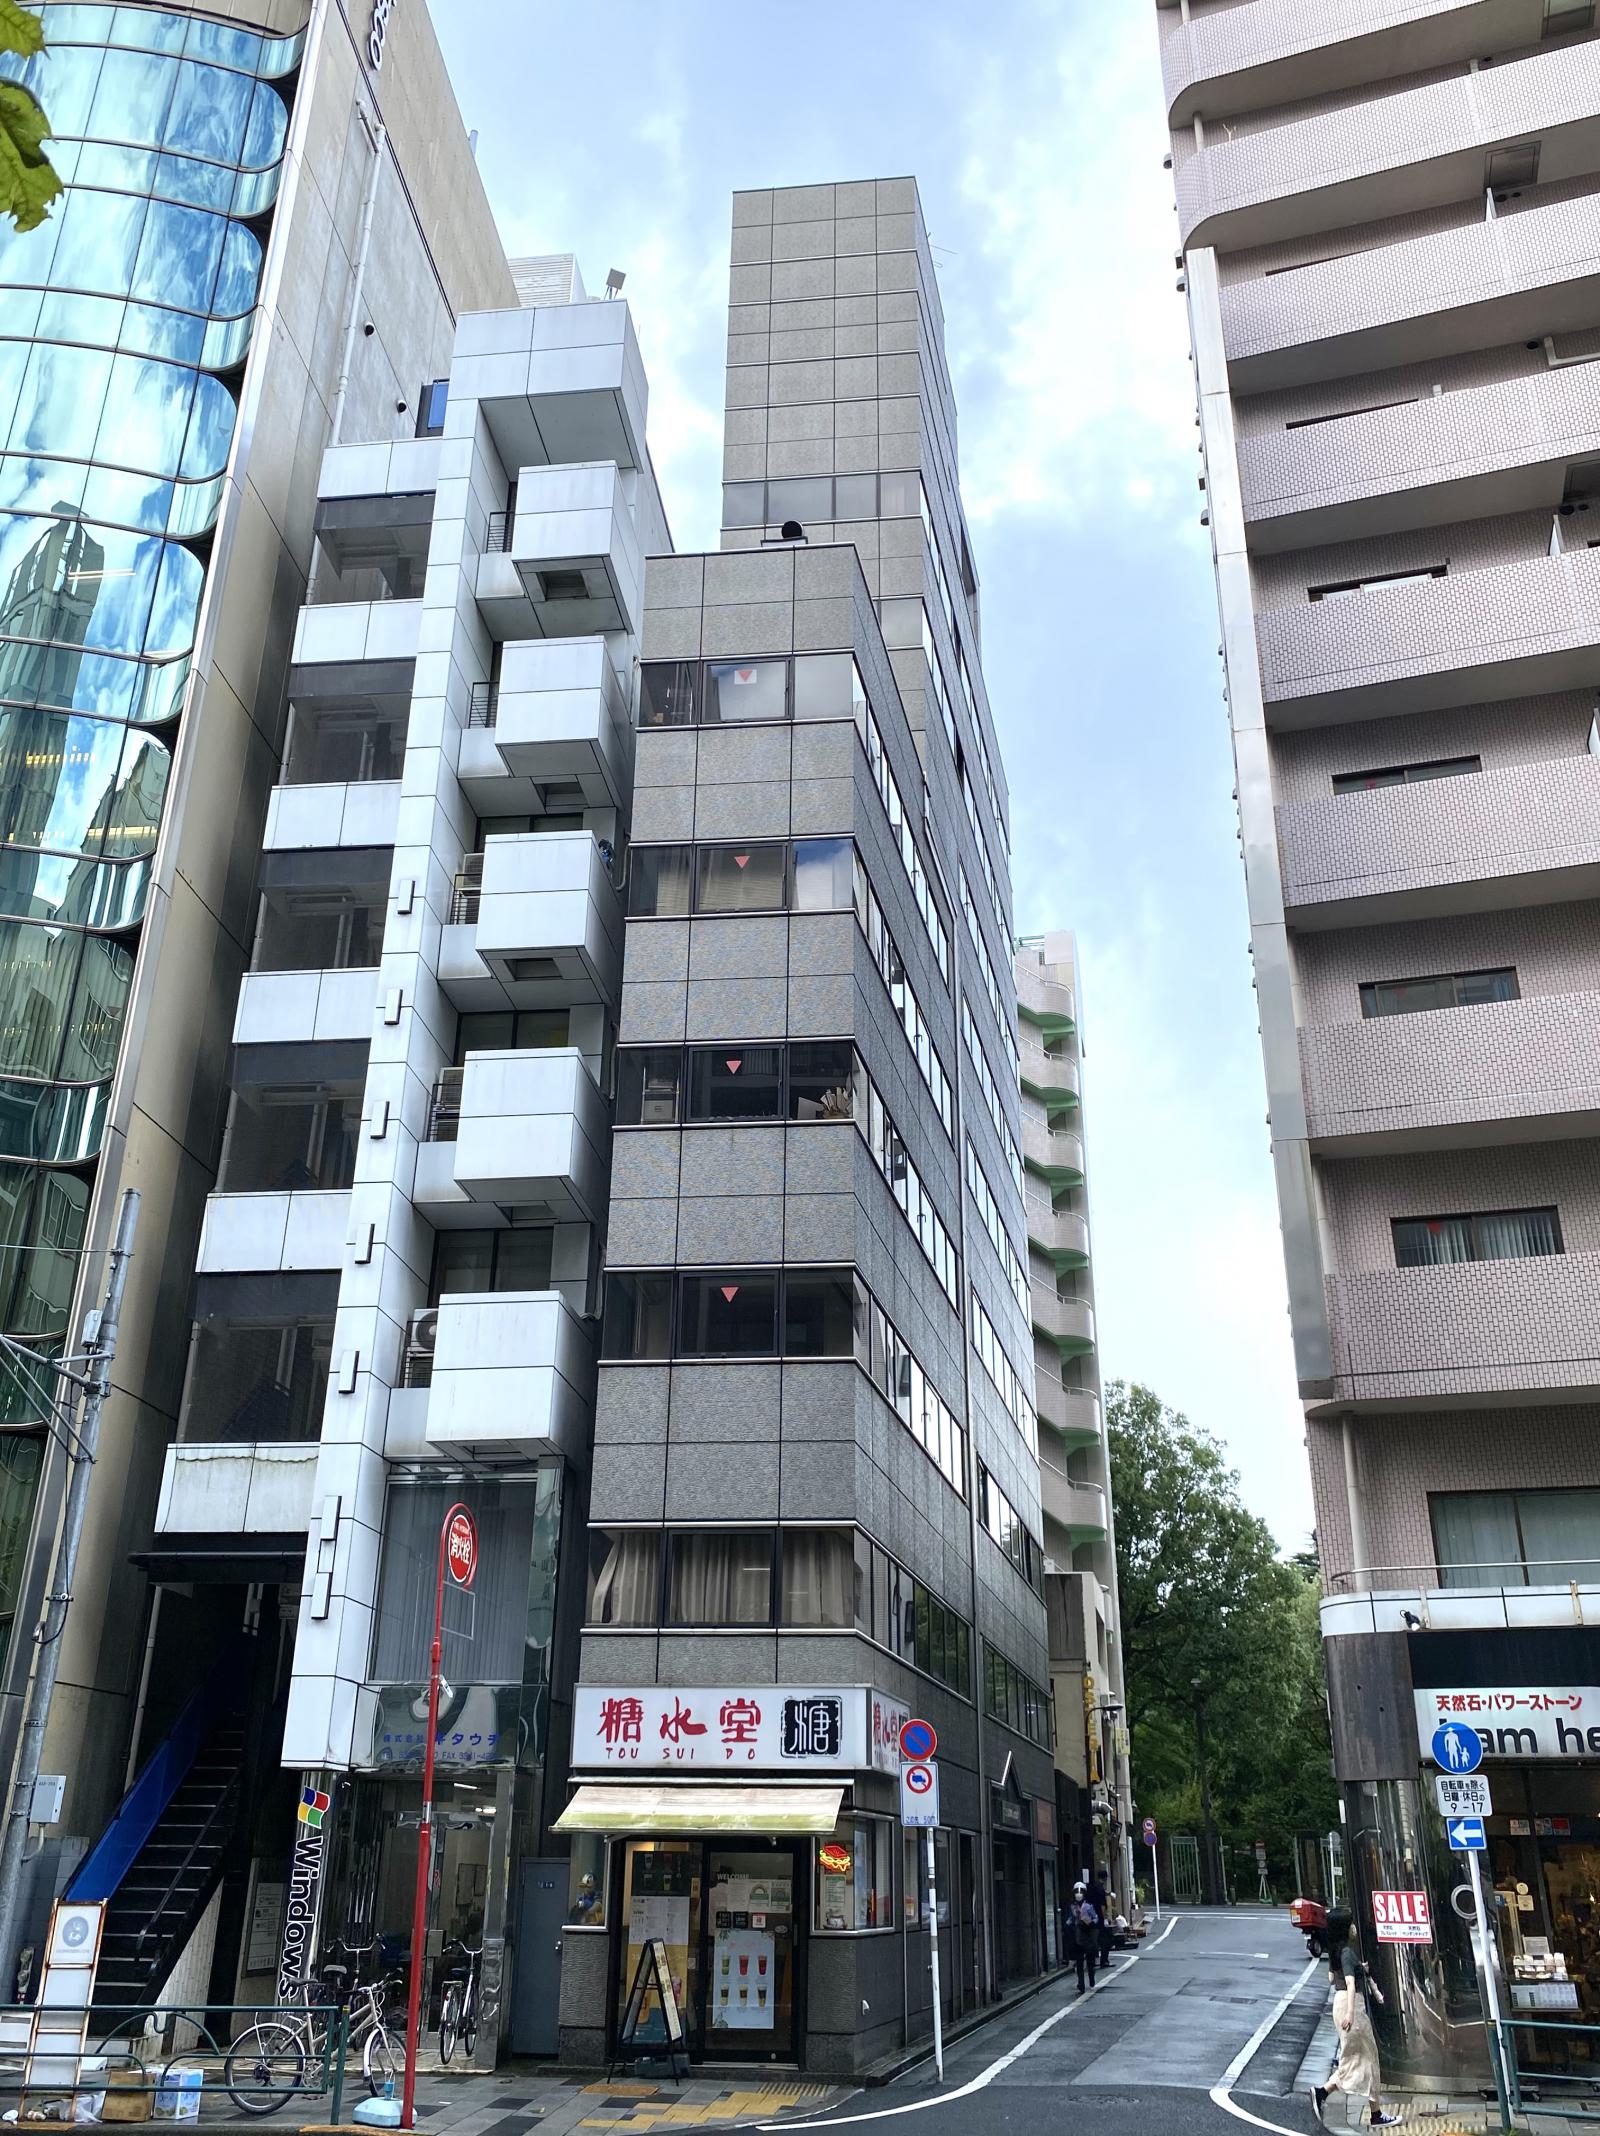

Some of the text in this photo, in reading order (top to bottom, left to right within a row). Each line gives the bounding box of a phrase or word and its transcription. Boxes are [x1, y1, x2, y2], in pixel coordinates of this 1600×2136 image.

[450, 1532, 470, 1564] 消火栓
[597, 1696, 762, 1743] 糖水堂
[786, 1700, 837, 1755] 糖
[606, 1747, 756, 1760] TOU SUI DO
[1441, 1779, 1485, 1791] 自転車を除く
[279, 1835, 324, 1999] Windows
[1375, 1894, 1428, 1922] SALE
